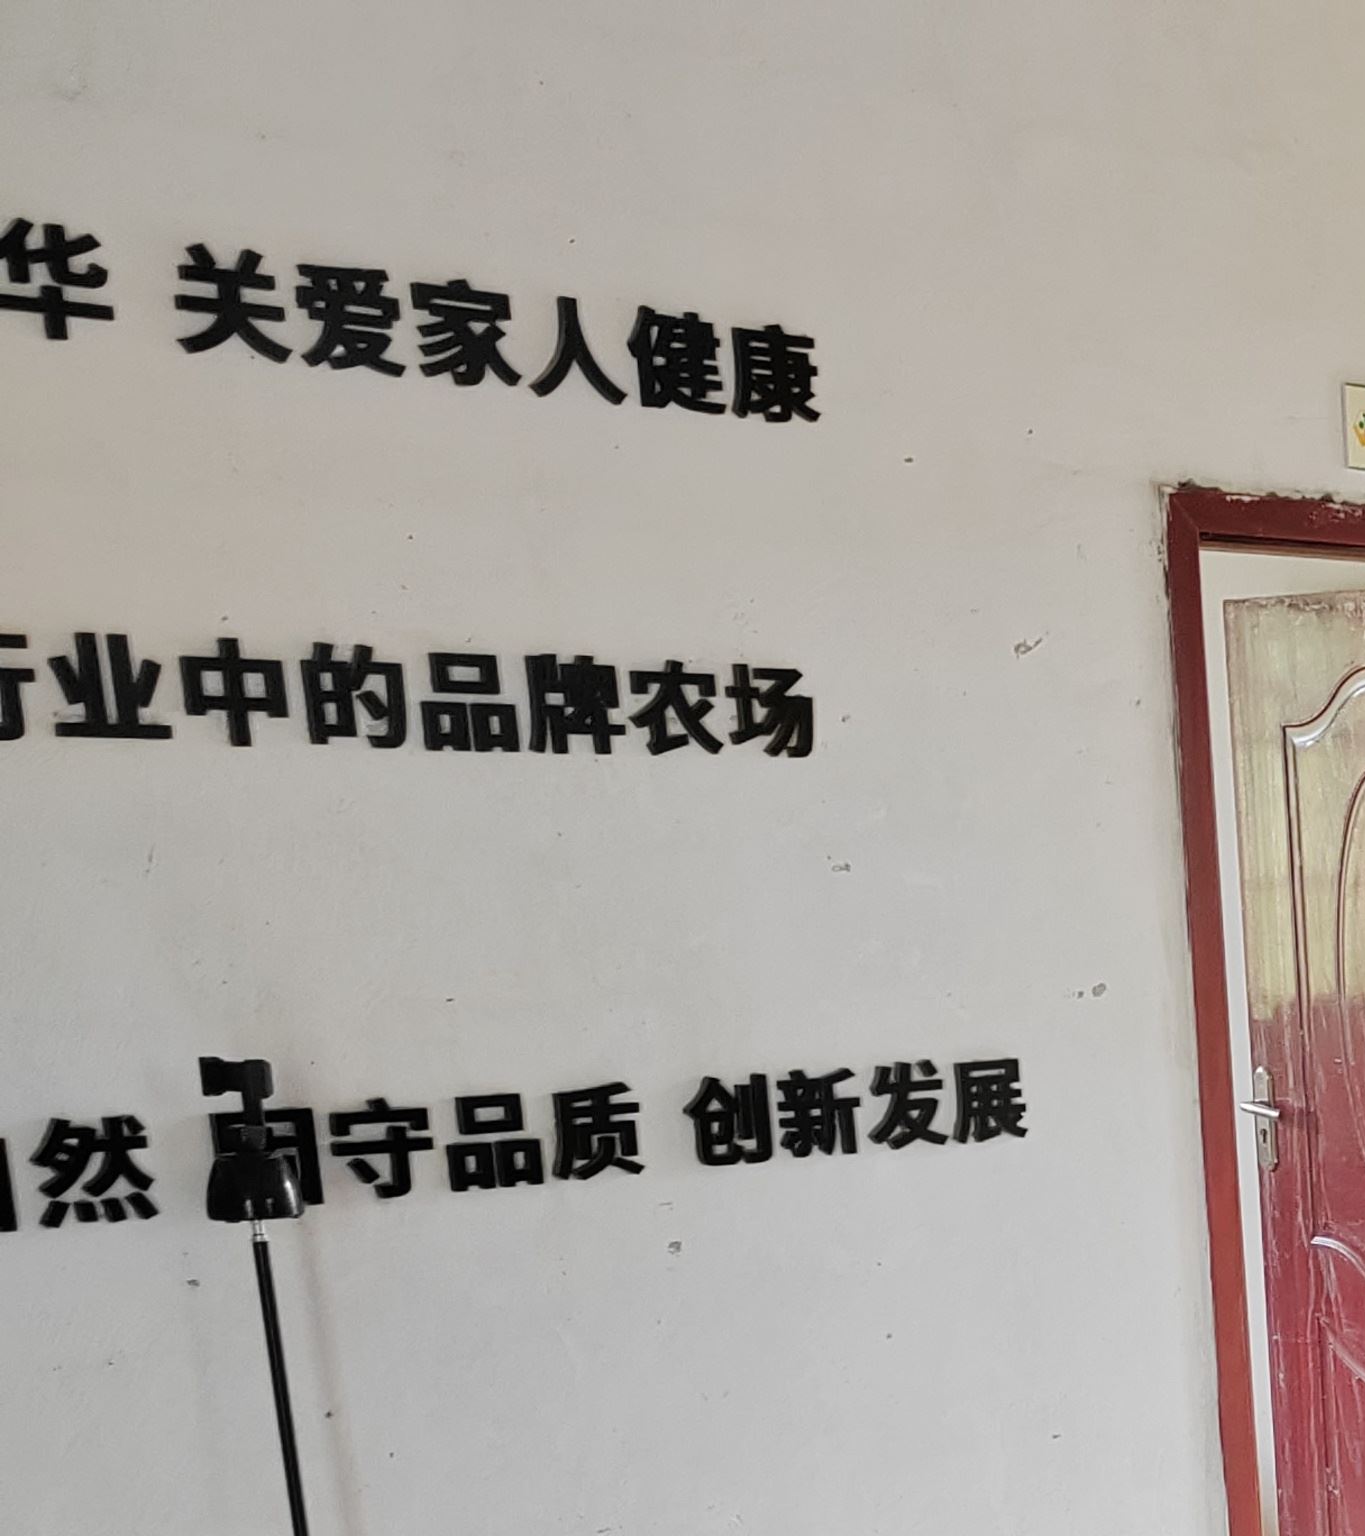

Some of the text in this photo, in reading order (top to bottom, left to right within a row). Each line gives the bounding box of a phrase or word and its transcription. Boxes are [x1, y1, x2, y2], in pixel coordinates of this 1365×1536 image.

[174, 243, 821, 423] 关爱家人健康
[0, 1114, 159, 1233] 然
[682, 1058, 1028, 1167] 创新发展
